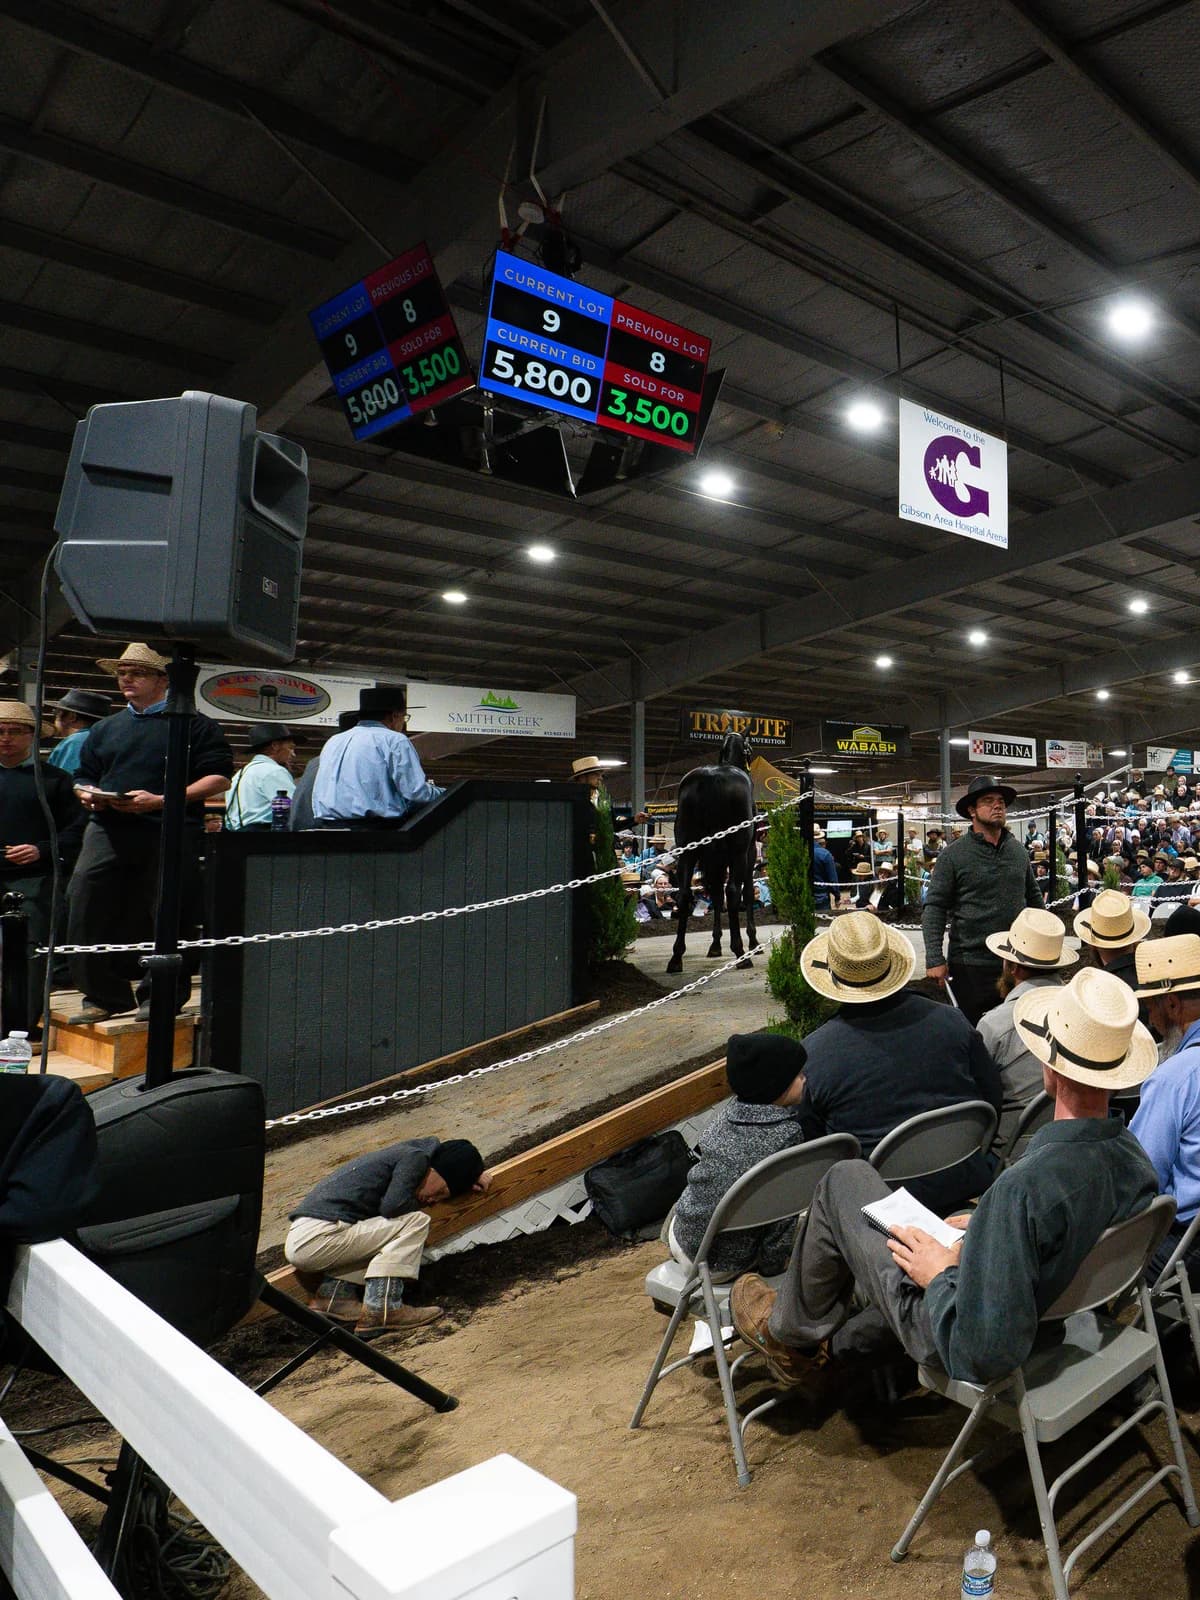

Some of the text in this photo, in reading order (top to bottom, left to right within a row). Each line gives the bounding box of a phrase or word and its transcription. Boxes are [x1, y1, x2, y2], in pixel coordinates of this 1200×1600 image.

[372, 259, 431, 299] PREVIOUS LOT
[504, 269, 605, 316] CURRENT LOT
[402, 299, 417, 323] 8
[542, 310, 560, 333] 9
[344, 332, 358, 357] 9
[401, 327, 442, 356] SOLD FOR
[497, 328, 596, 371] CURRENT BID
[616, 314, 705, 357] PREVIOUS LOT
[402, 346, 462, 396] 3,500
[491, 349, 592, 404] 5,800
[649, 352, 665, 373] 8
[346, 377, 400, 424] 5,800
[623, 373, 685, 403] SOLD FOR
[607, 389, 689, 436] 3,500
[922, 411, 985, 445] Welcome to the
[900, 503, 1007, 544] Gibson Area Hospital Arena
[277, 677, 318, 695] SILVER
[448, 712, 542, 727] SMITH CREEK
[751, 737, 786, 745] NUTRITION
[836, 741, 897, 753] WABASH
[985, 742, 1031, 757] PURINA
